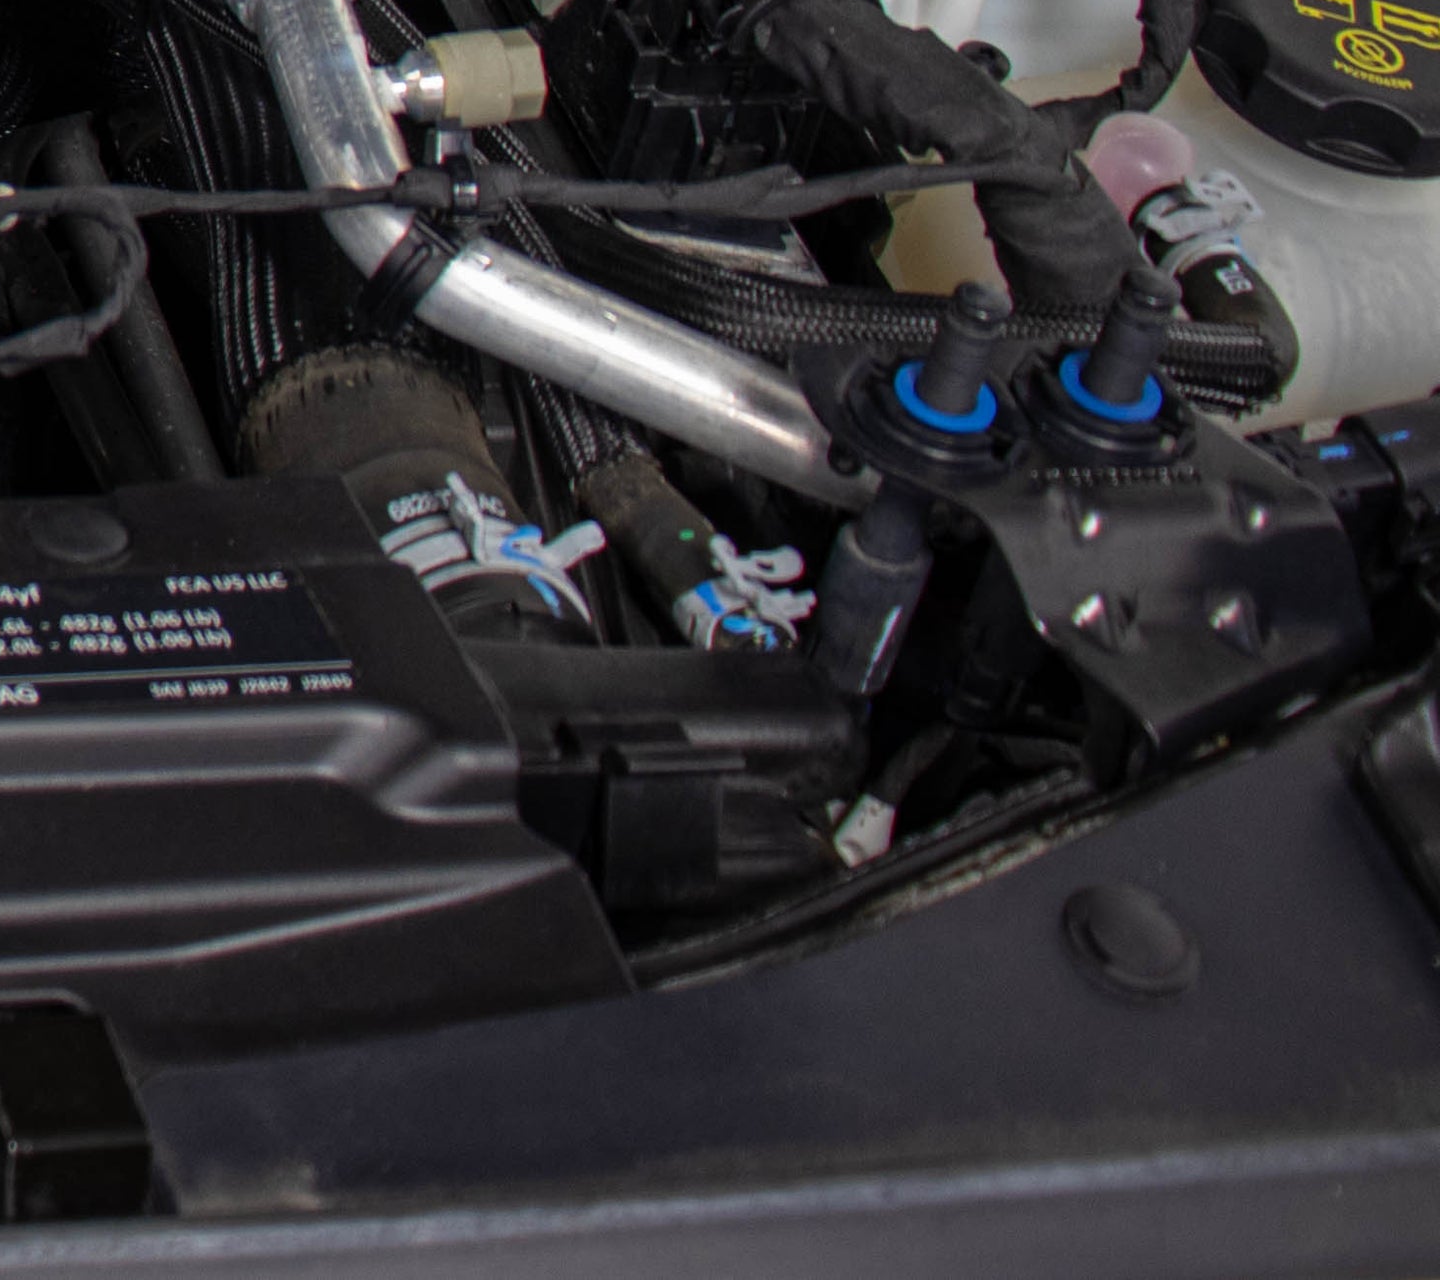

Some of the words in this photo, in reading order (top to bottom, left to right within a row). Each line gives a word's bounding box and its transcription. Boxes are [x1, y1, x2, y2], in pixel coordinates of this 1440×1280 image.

[165, 575, 210, 595] FCA
[213, 573, 246, 593] US
[247, 571, 288, 591] LLC
[58, 613, 118, 634] 482g
[68, 633, 128, 656] 482g
[149, 681, 185, 700] SAE
